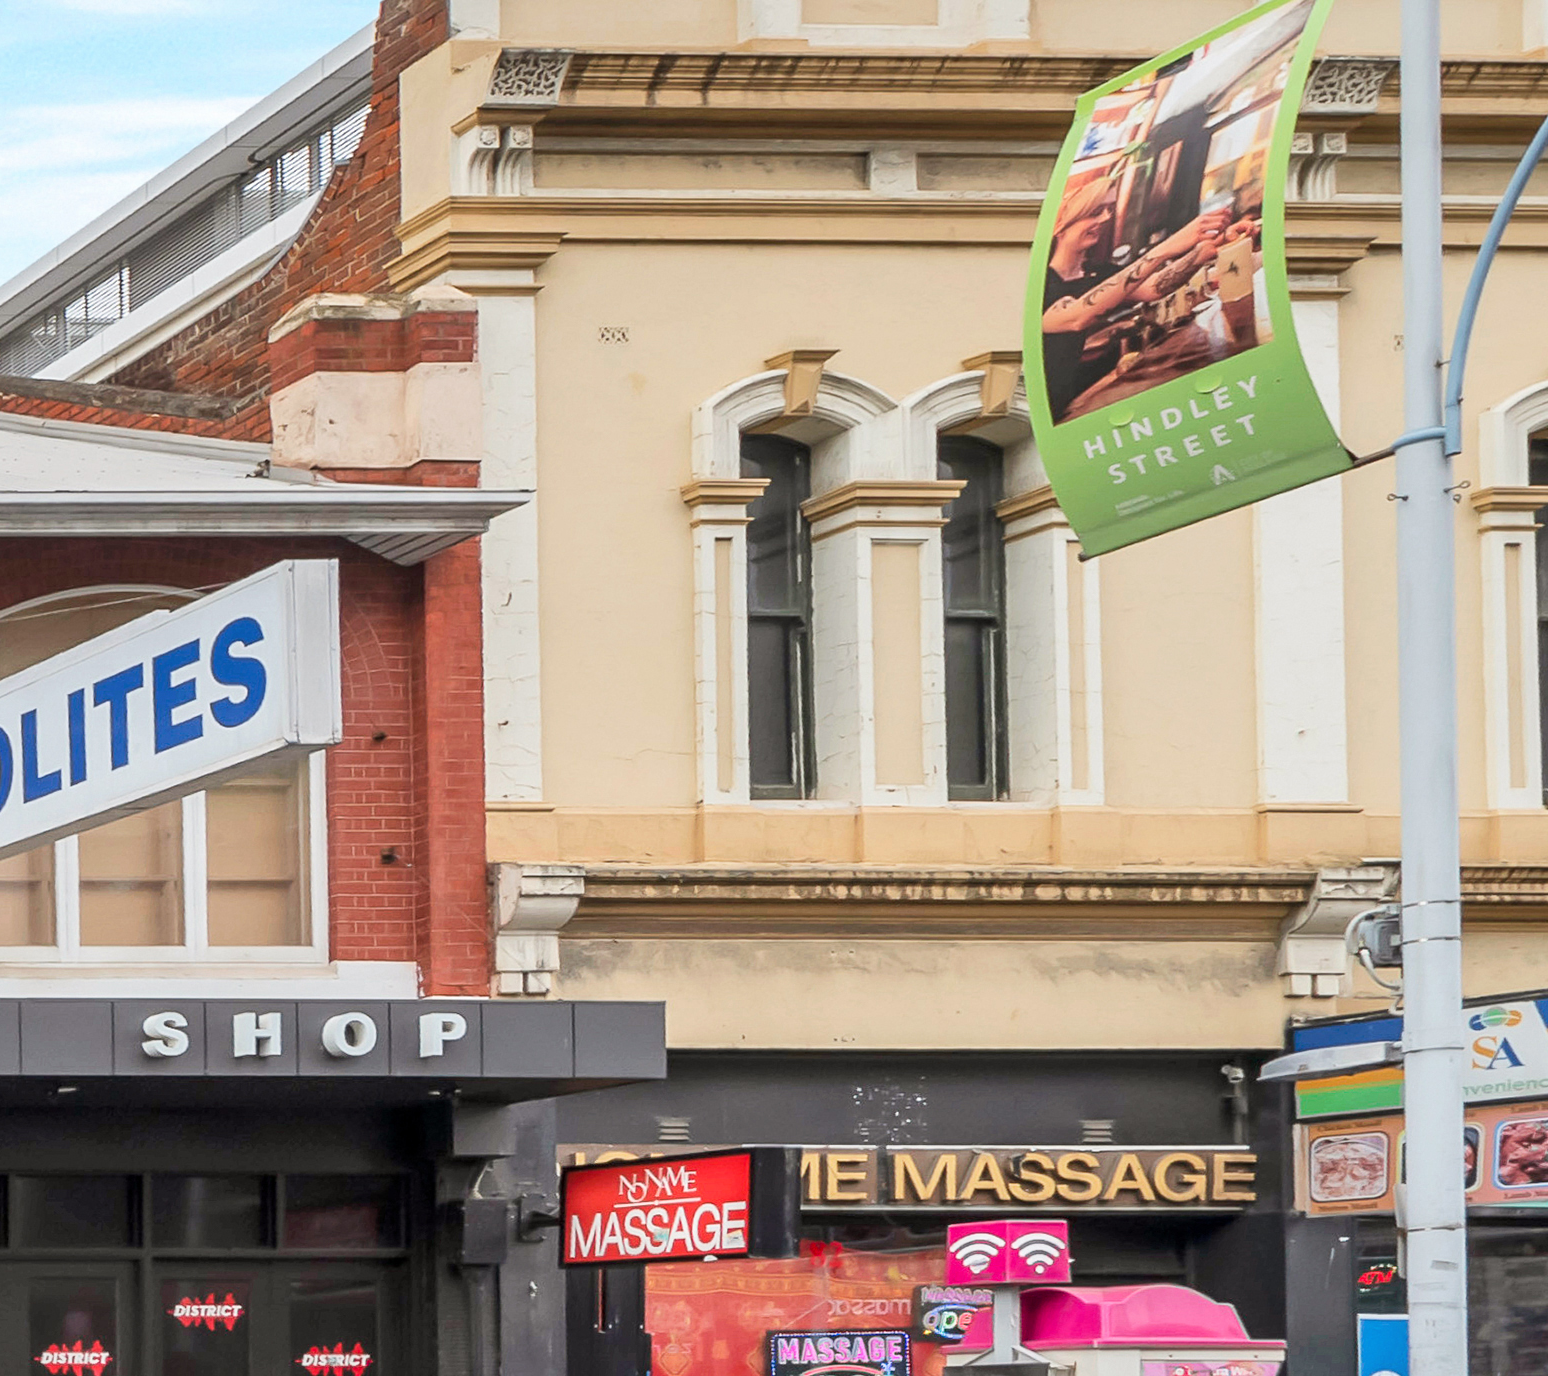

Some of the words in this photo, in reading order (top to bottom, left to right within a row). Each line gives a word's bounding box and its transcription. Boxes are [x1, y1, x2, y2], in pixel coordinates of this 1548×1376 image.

[1083, 375, 1257, 459] HINDLEY
[1108, 413, 1255, 484] STREET
[141, 1010, 468, 1059] SHOP
[1471, 1035, 1526, 1071] SA
[893, 1152, 1258, 1203] MASSAGE
[568, 1200, 747, 1259] MASSAGE
[173, 1304, 242, 1317] DISTRICT
[39, 1351, 110, 1365] DISTRICT
[777, 1336, 904, 1365] MASSAGE
